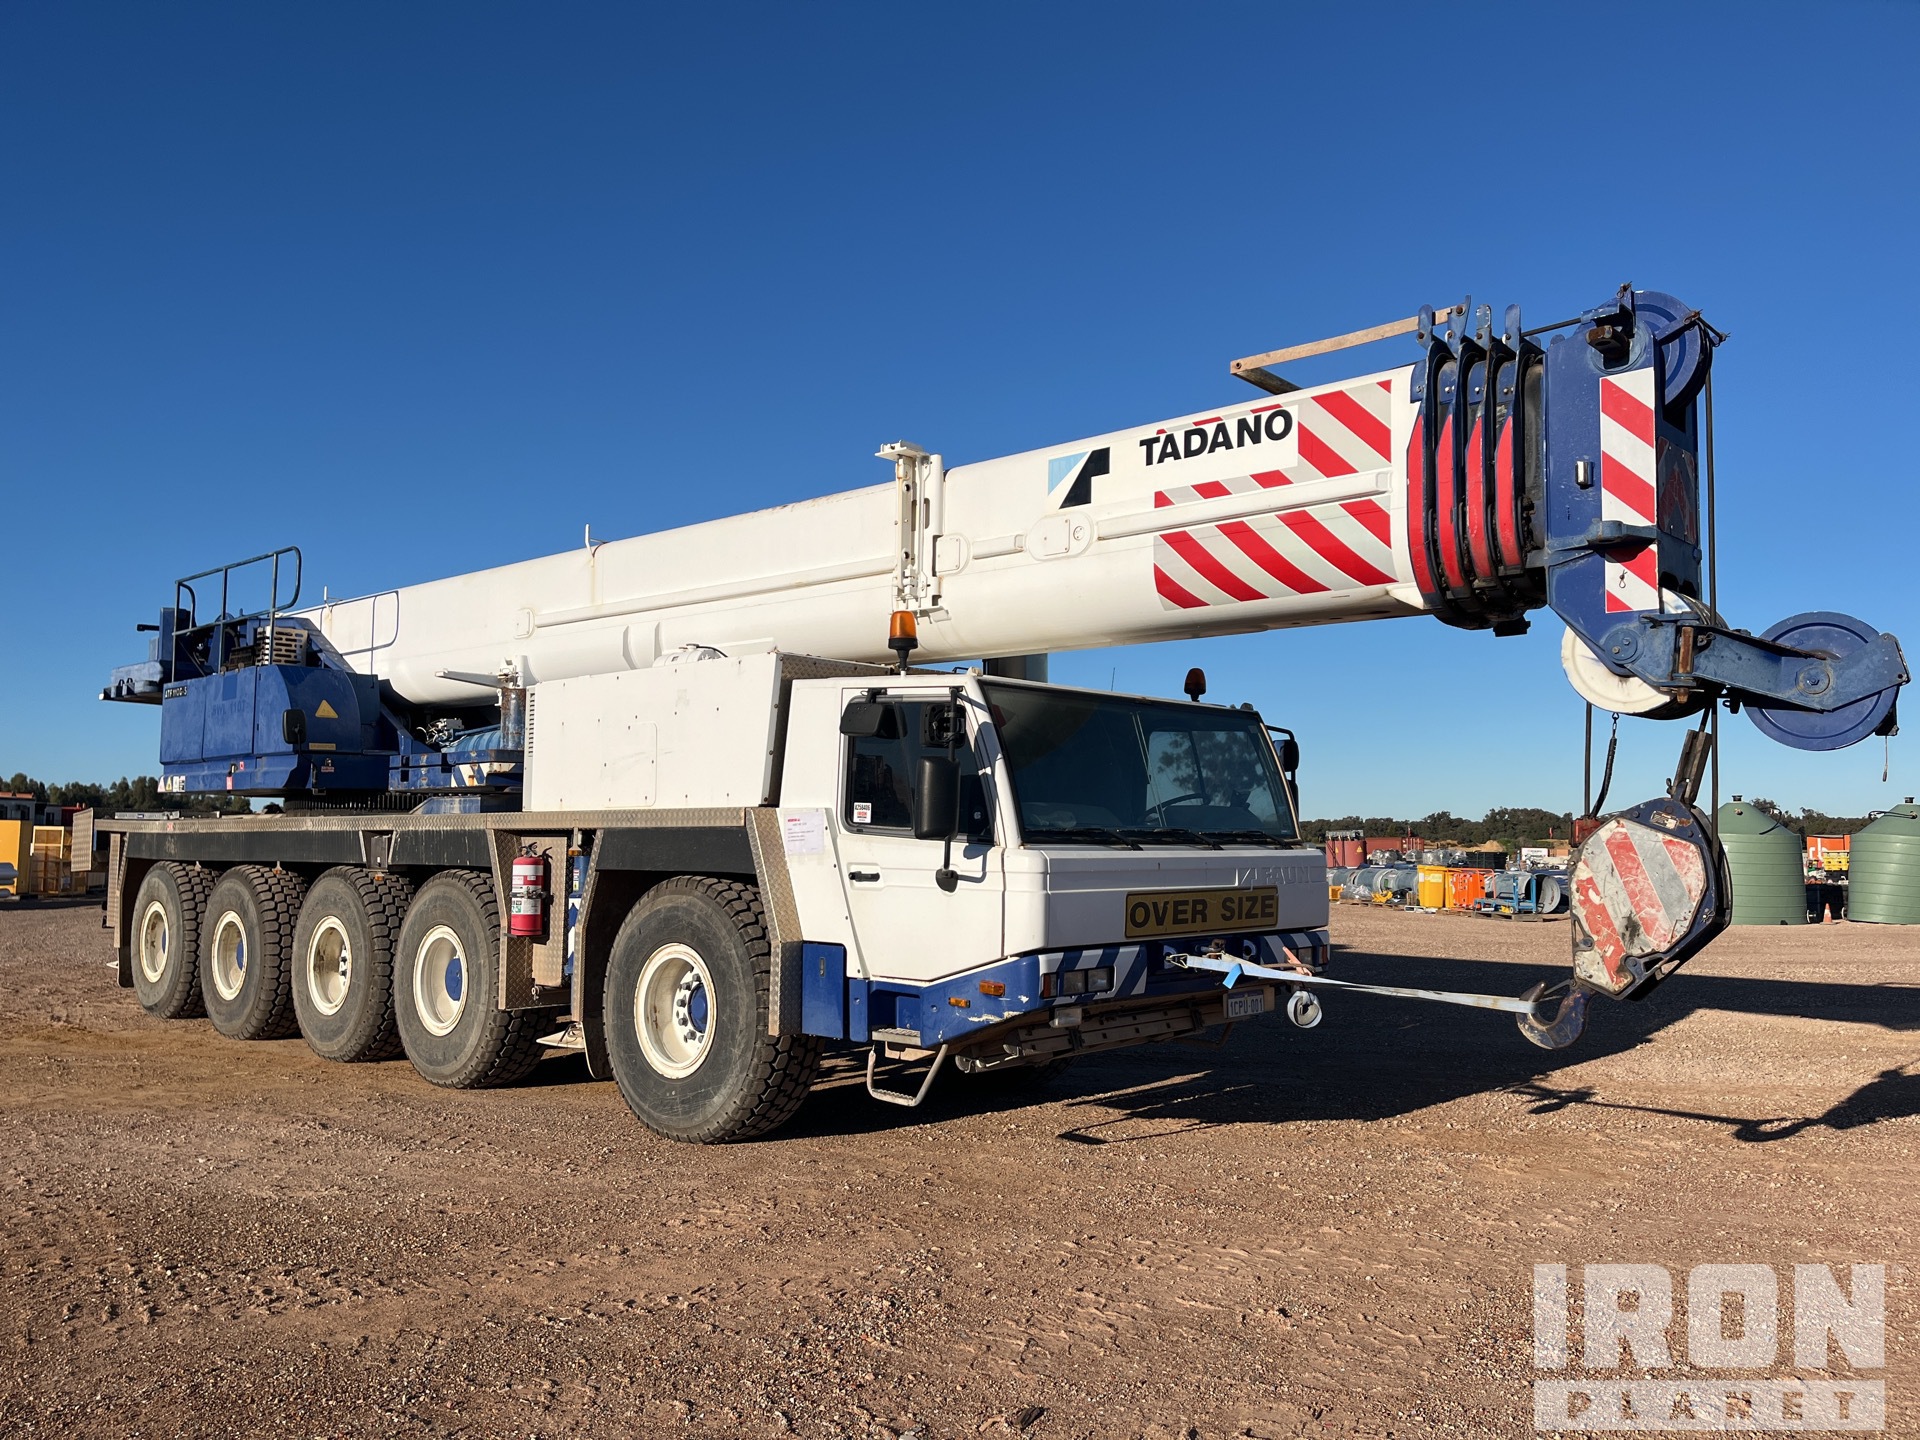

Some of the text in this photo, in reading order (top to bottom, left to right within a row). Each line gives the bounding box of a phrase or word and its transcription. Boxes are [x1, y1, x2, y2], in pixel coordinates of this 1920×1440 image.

[1139, 408, 1293, 467] TADANO
[1130, 895, 1275, 928] OVER SIZE
